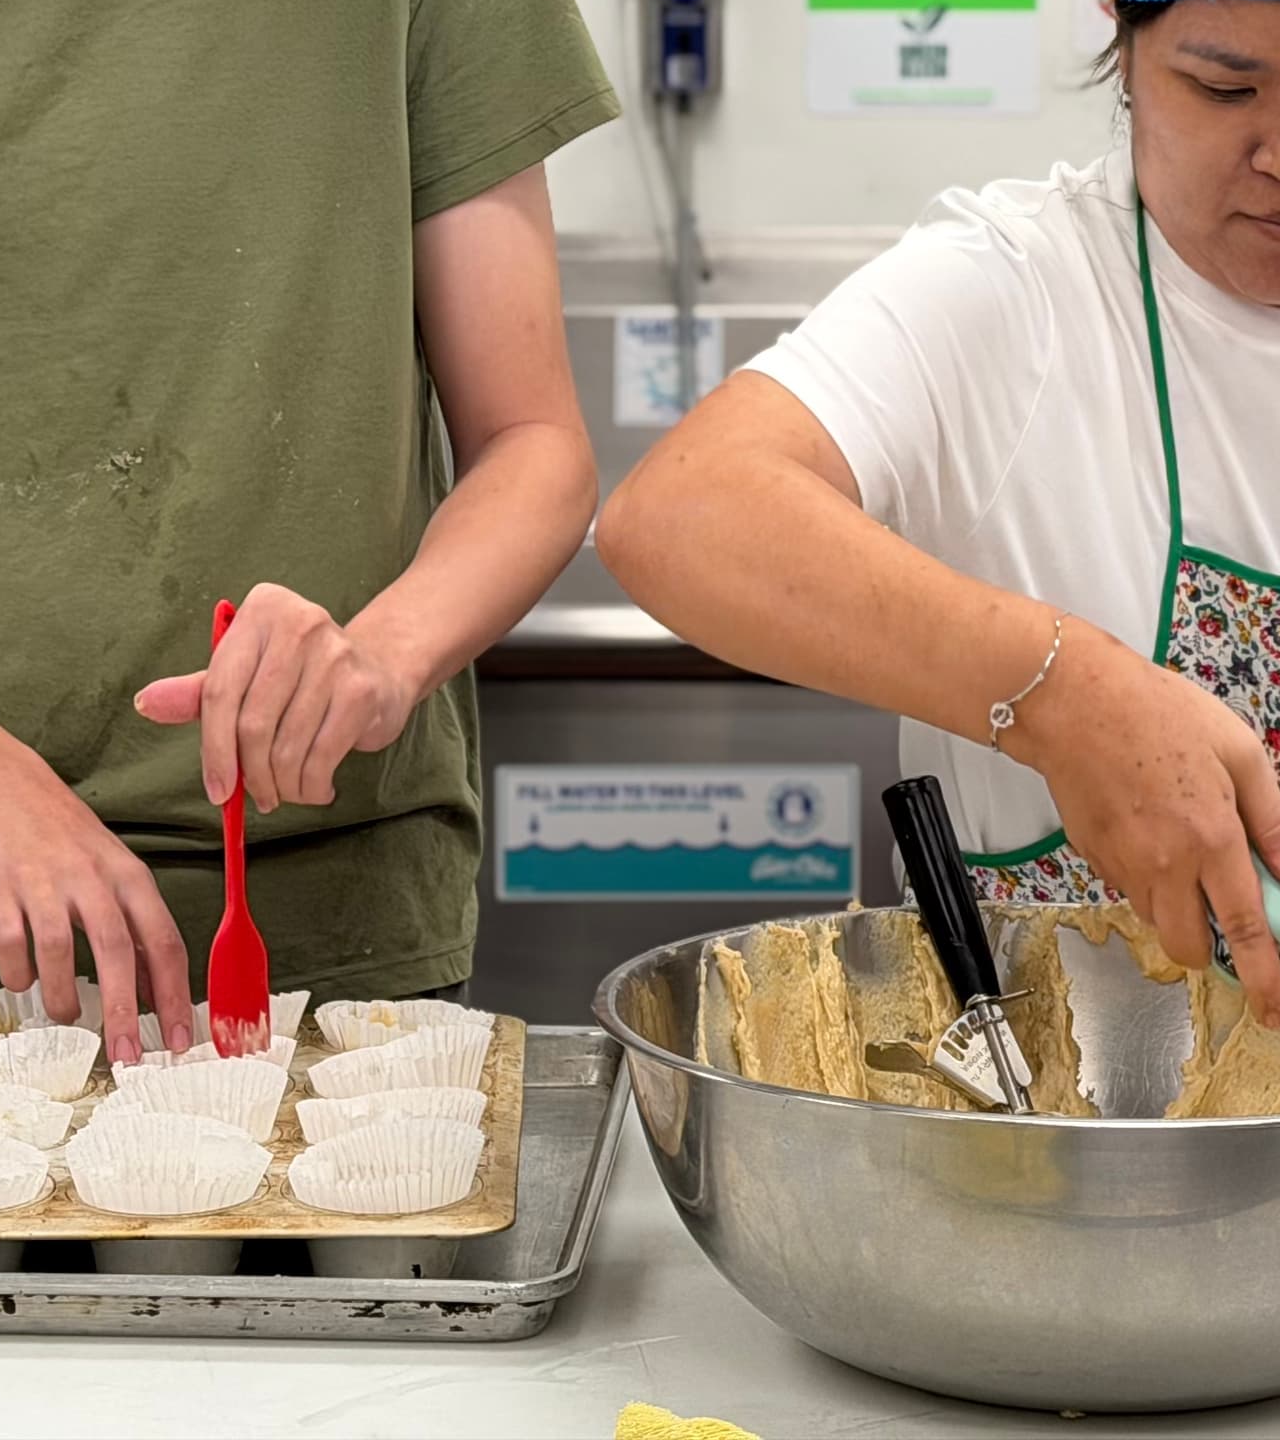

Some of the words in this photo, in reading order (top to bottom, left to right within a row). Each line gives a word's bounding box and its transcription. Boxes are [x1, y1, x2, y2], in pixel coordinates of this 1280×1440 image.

[516, 783, 553, 801] FILL
[559, 784, 617, 801] WATER
[622, 784, 644, 800] TO
[648, 784, 687, 800] THIS
[691, 784, 746, 801] LEVEL
